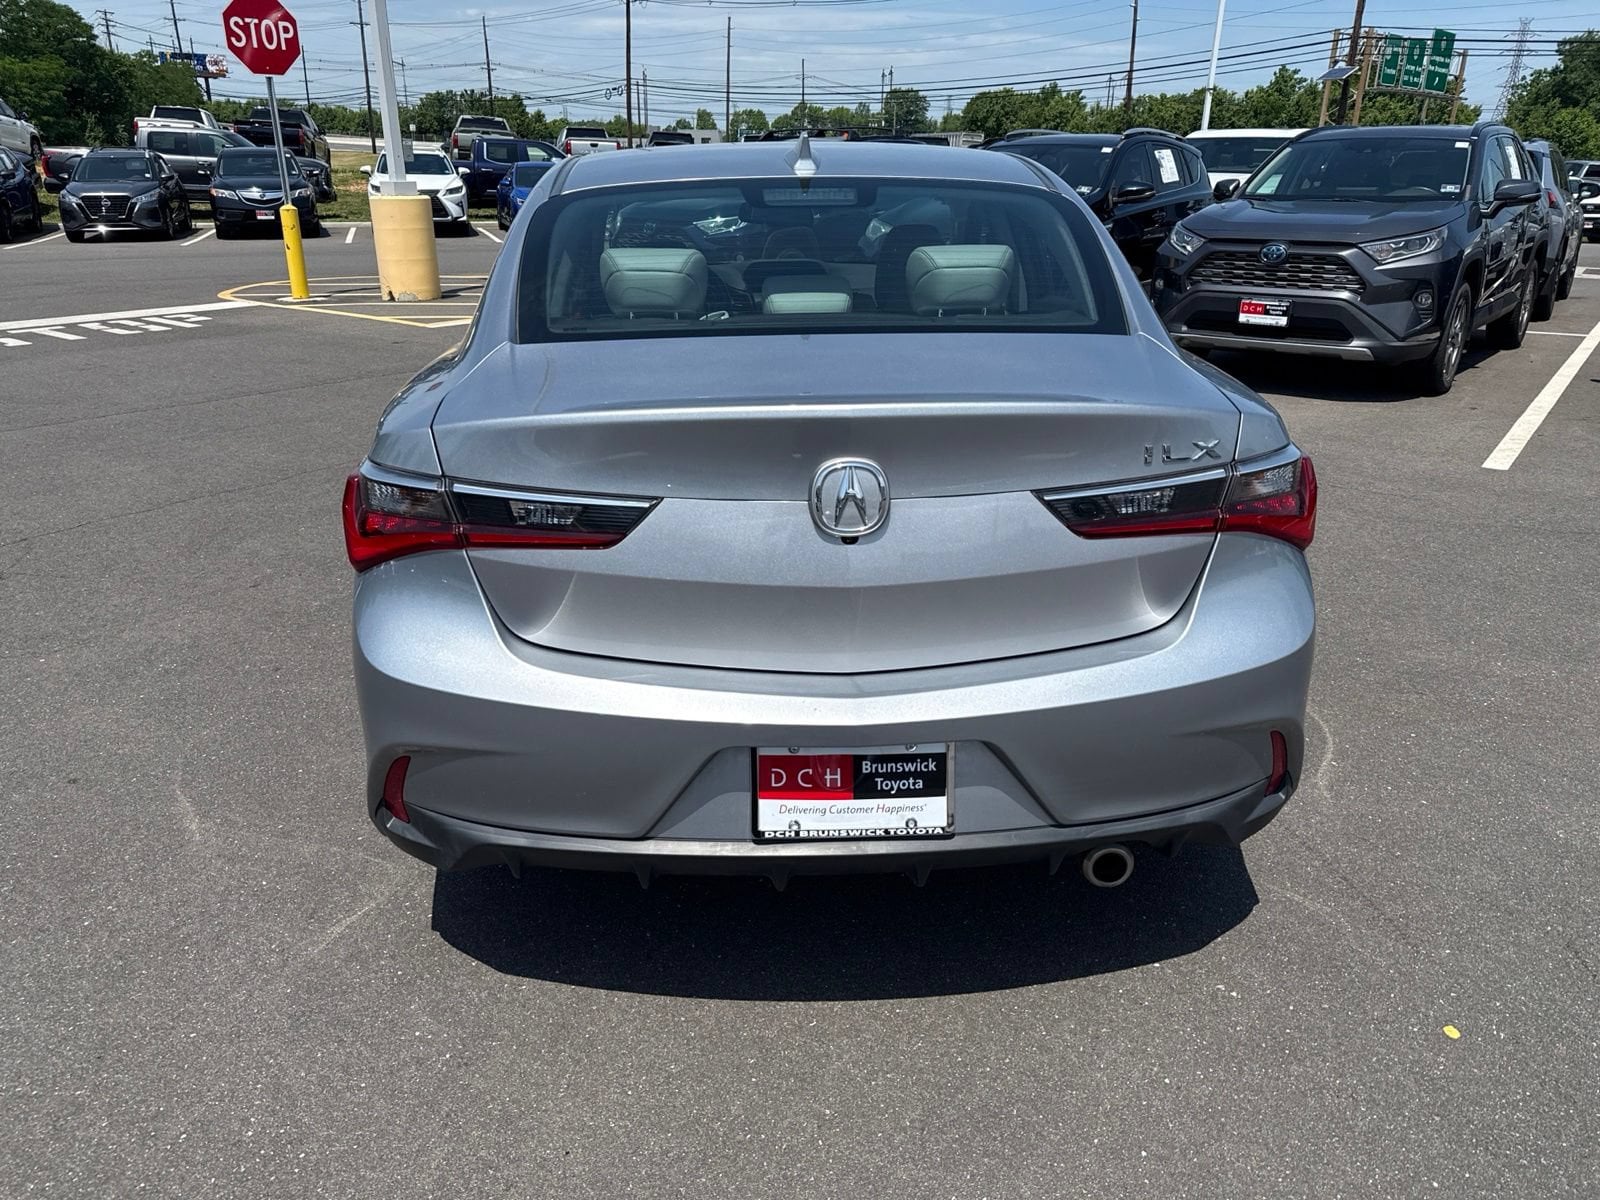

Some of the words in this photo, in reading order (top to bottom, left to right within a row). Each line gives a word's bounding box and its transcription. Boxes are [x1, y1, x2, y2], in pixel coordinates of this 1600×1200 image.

[229, 16, 294, 51] STOP
[1143, 439, 1221, 466] ILX
[862, 758, 937, 773] Brunswick
[875, 777, 923, 794] Toyota
[779, 804, 827, 816] Delivering
[828, 804, 874, 814] Customer
[764, 830, 795, 839] DCH
[799, 829, 886, 838] BRUNSWICK
[889, 827, 943, 836] TOYOTA
